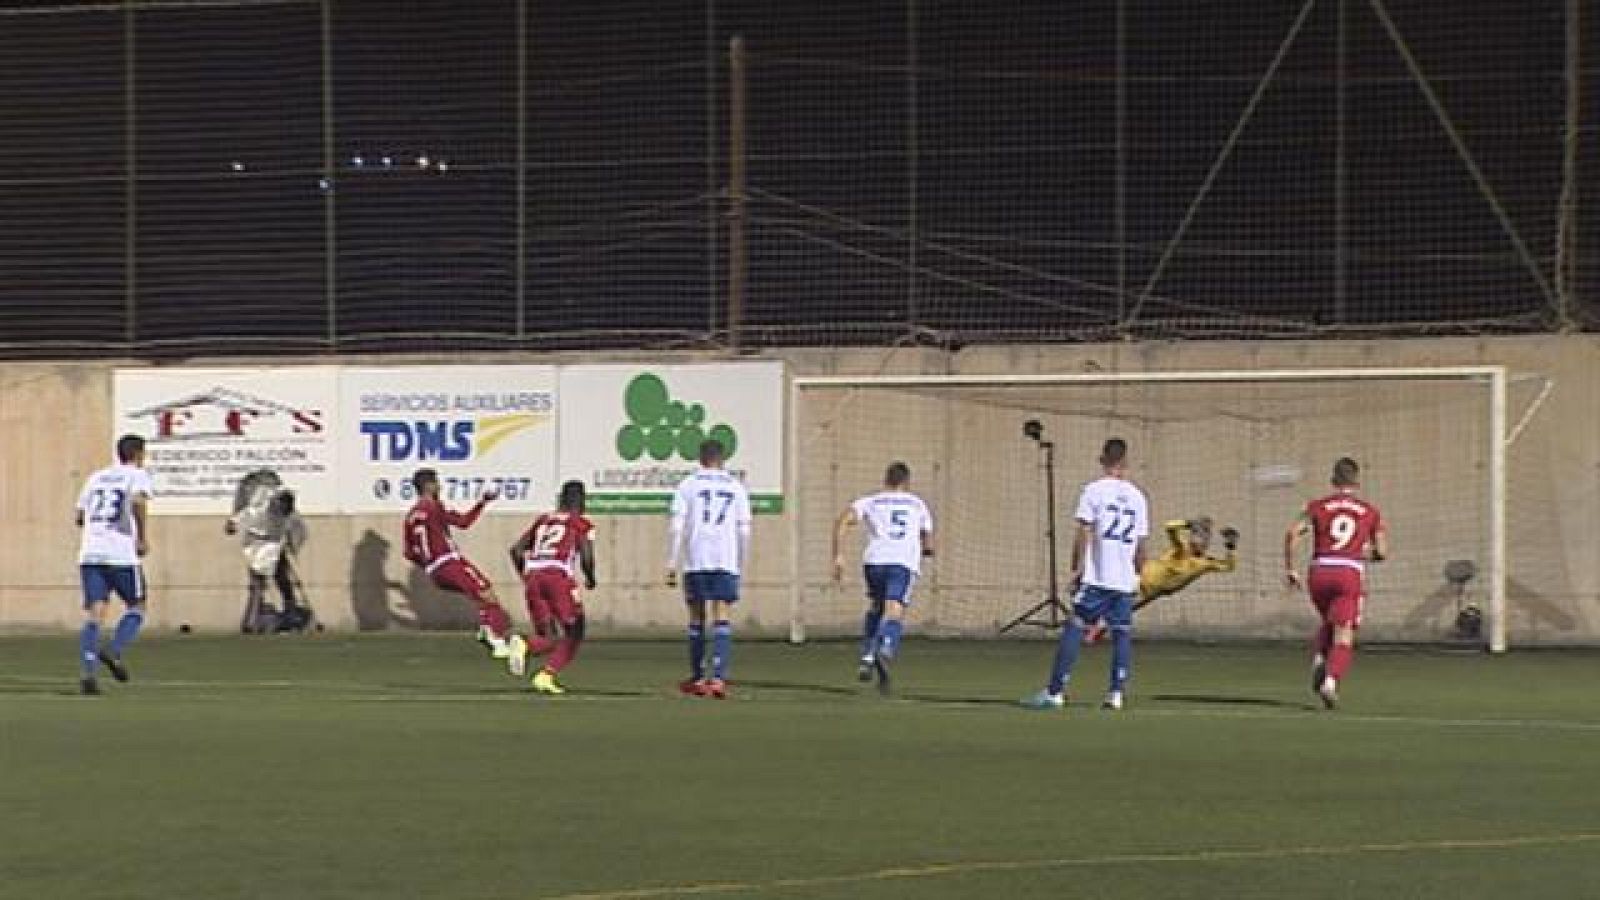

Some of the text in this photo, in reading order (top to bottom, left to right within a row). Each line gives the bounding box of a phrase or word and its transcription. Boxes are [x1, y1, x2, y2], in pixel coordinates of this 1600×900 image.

[360, 392, 551, 411] SERVICIOS AUXILIARES
[151, 446, 307, 461] EDERICO FALCÓN
[360, 420, 474, 460] TDMS
[90, 488, 125, 523] 23
[445, 477, 485, 501] 717
[698, 489, 735, 525] 17
[1103, 503, 1136, 544] 22
[534, 524, 566, 556] 12
[889, 509, 909, 540] 5
[1330, 513, 1356, 551] 9
